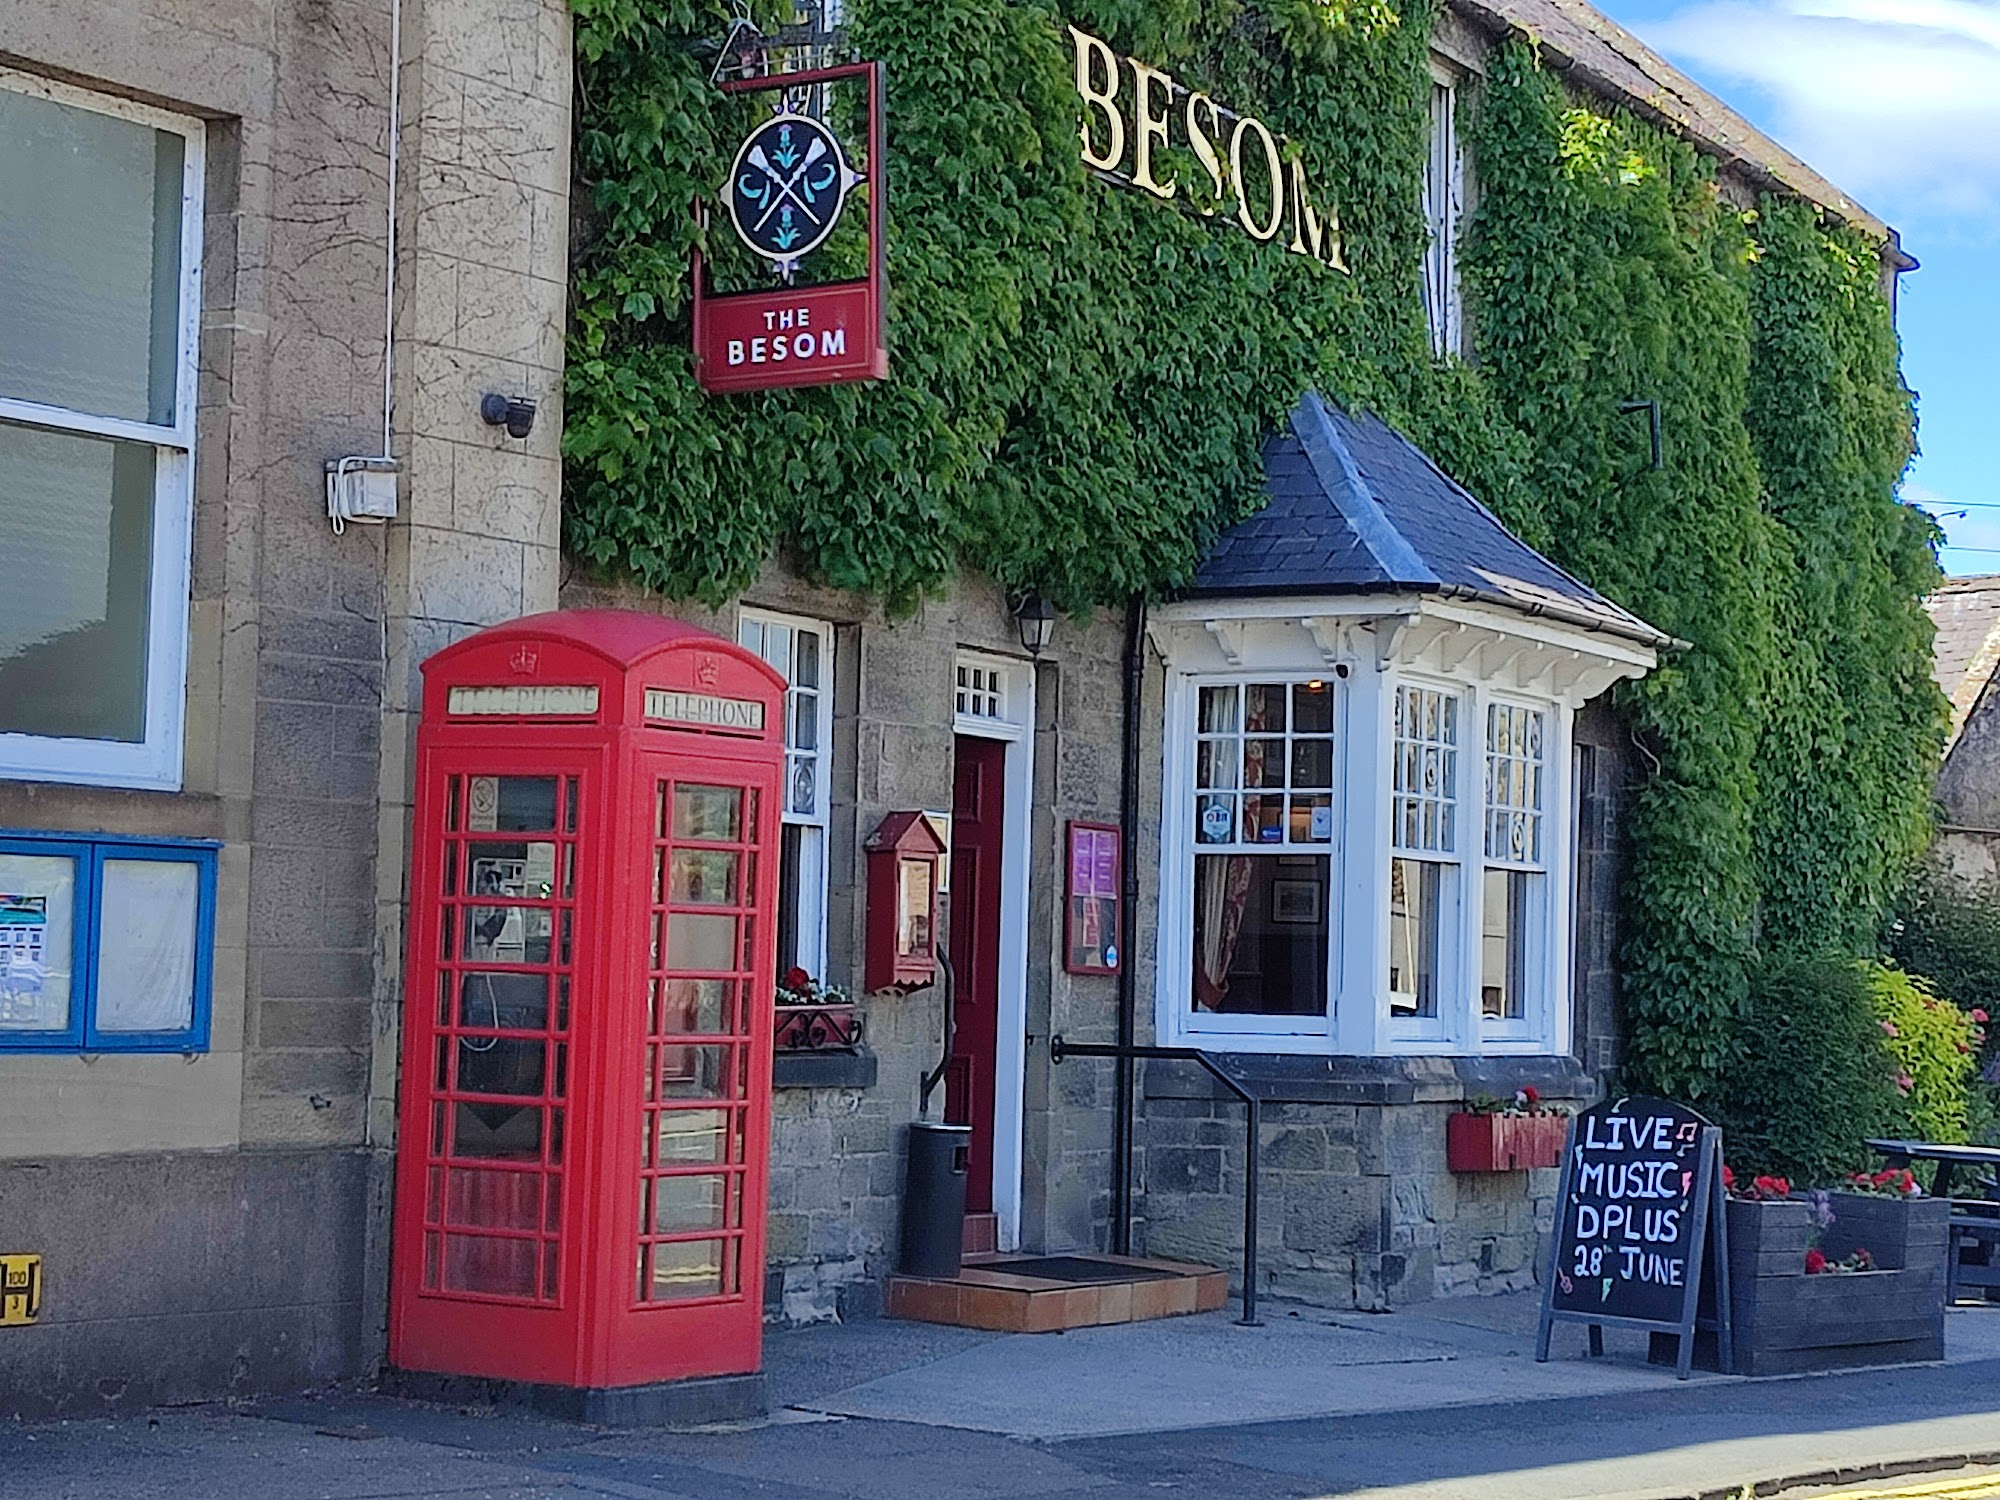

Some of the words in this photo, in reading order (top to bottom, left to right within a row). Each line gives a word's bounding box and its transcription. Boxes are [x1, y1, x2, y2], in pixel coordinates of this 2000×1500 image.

[1067, 24, 1351, 276] BESOM
[763, 308, 809, 331] THE
[728, 329, 845, 366] BESOM
[648, 692, 759, 727] TELEPHONE
[1585, 1115, 1674, 1151] LIVE
[1579, 1161, 1679, 1199] MUSIC
[1576, 1204, 1681, 1243] DPLUS
[9, 1271, 27, 1285] 100
[1619, 1246, 1684, 1287] JUNE
[0, 1262, 36, 1318] H
[12, 1295, 19, 1310] 3
